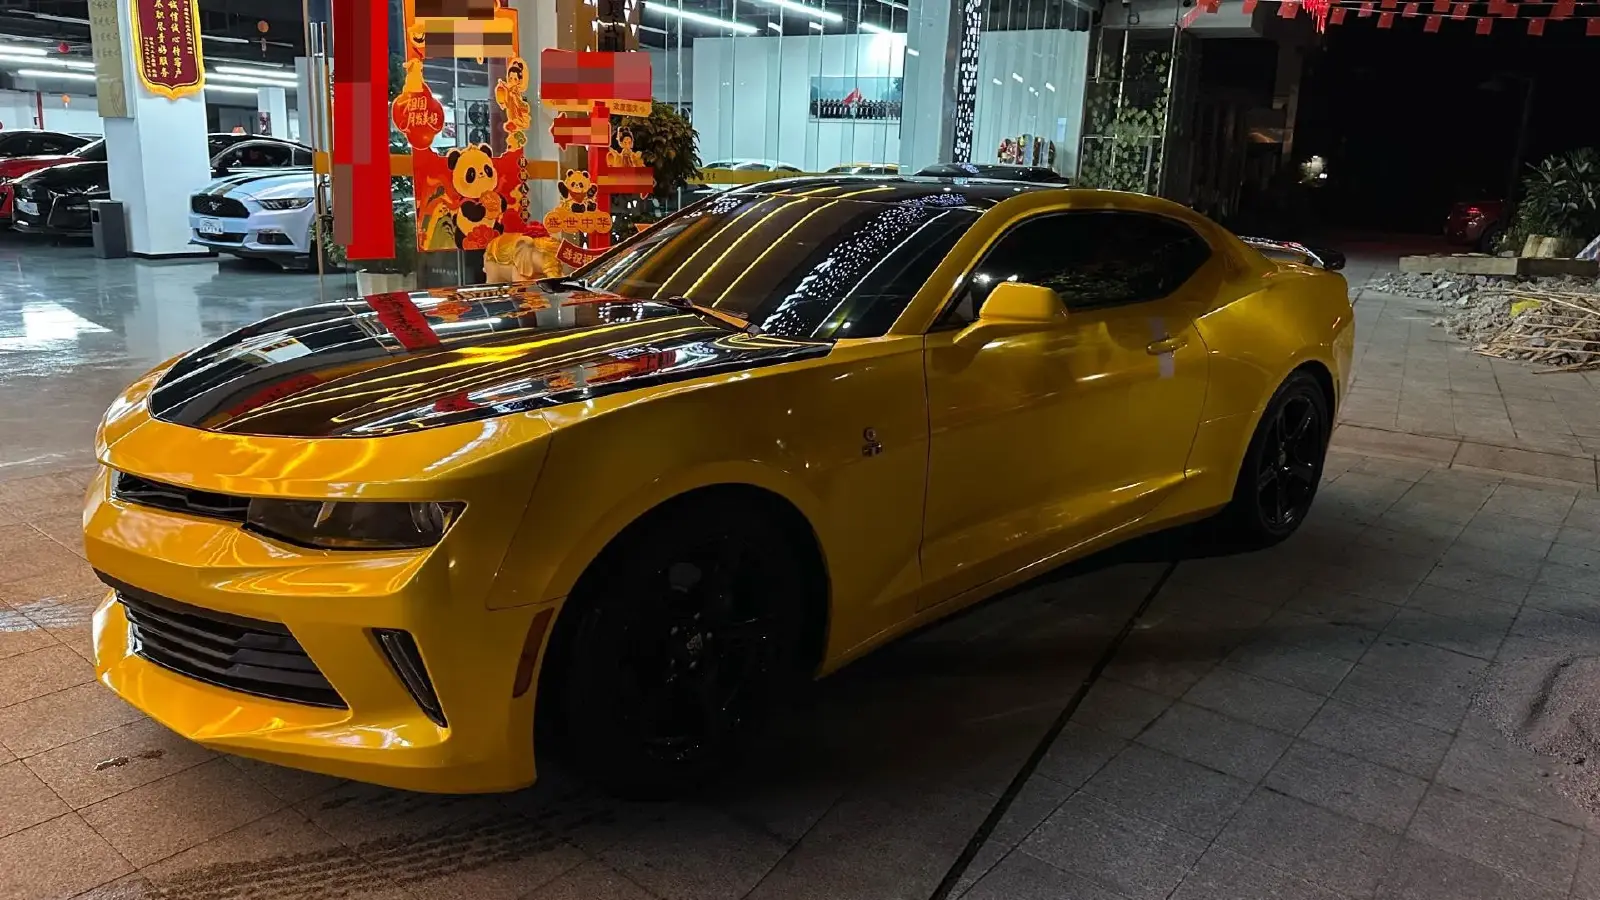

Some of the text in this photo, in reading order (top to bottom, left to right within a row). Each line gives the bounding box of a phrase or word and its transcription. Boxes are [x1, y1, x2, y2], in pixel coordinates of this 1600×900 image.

[547, 216, 610, 229] 盛世中华
[562, 247, 598, 265] 恭祝祖
